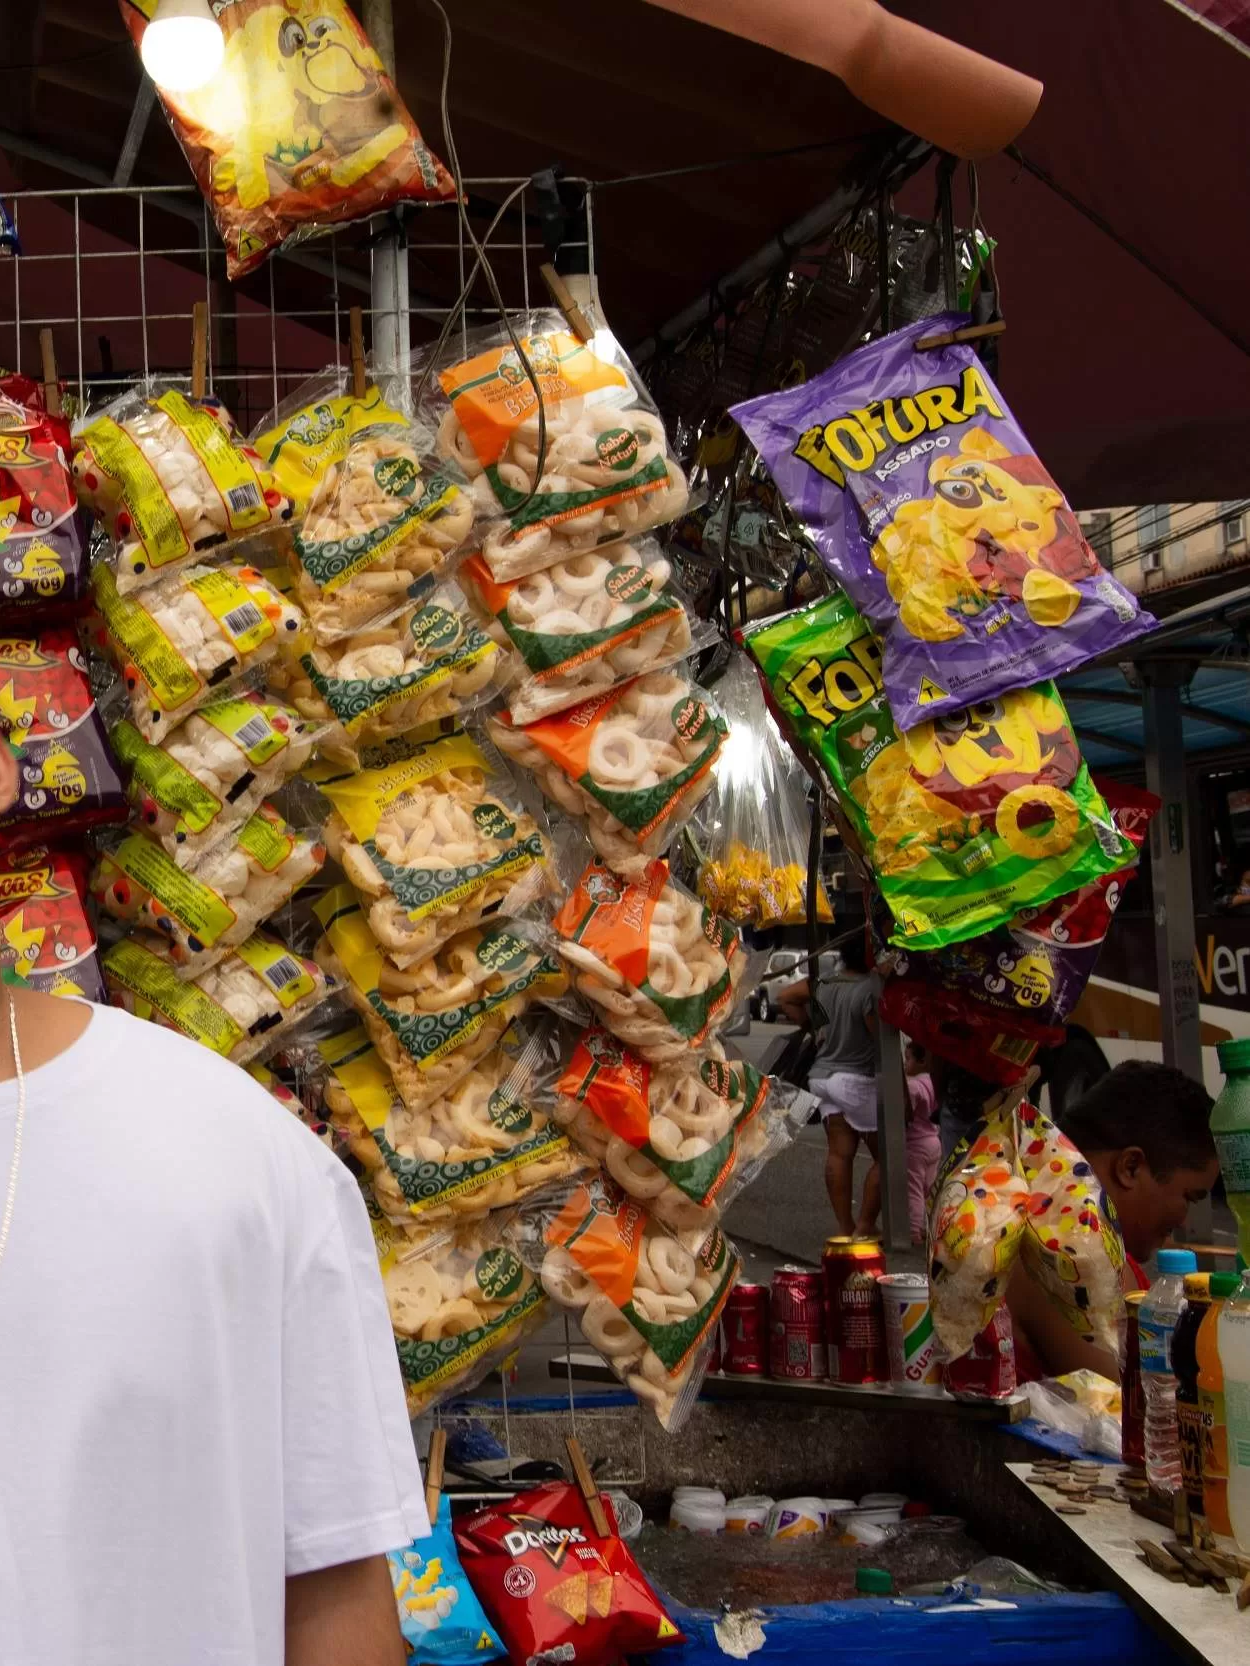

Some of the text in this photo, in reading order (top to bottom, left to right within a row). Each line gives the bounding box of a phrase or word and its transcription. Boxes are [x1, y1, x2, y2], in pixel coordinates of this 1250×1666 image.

[599, 429, 629, 455] Sabor
[793, 365, 1008, 491] FOFURA
[598, 435, 641, 469] Natural
[873, 434, 951, 483] ASSADO
[30, 576, 61, 593] 70g
[608, 566, 639, 594] Sabor
[609, 567, 654, 608] Natural
[412, 608, 445, 636] Sabor
[413, 610, 463, 652] Cebola
[922, 685, 934, 698] T
[860, 735, 892, 770] CEBOLA
[52, 783, 83, 801] 70g
[479, 933, 510, 962] Sabor
[485, 939, 528, 974] Cebola
[1013, 983, 1043, 1006] 70g
[478, 1248, 507, 1288] Sabor
[504, 1526, 587, 1556] Doritos
